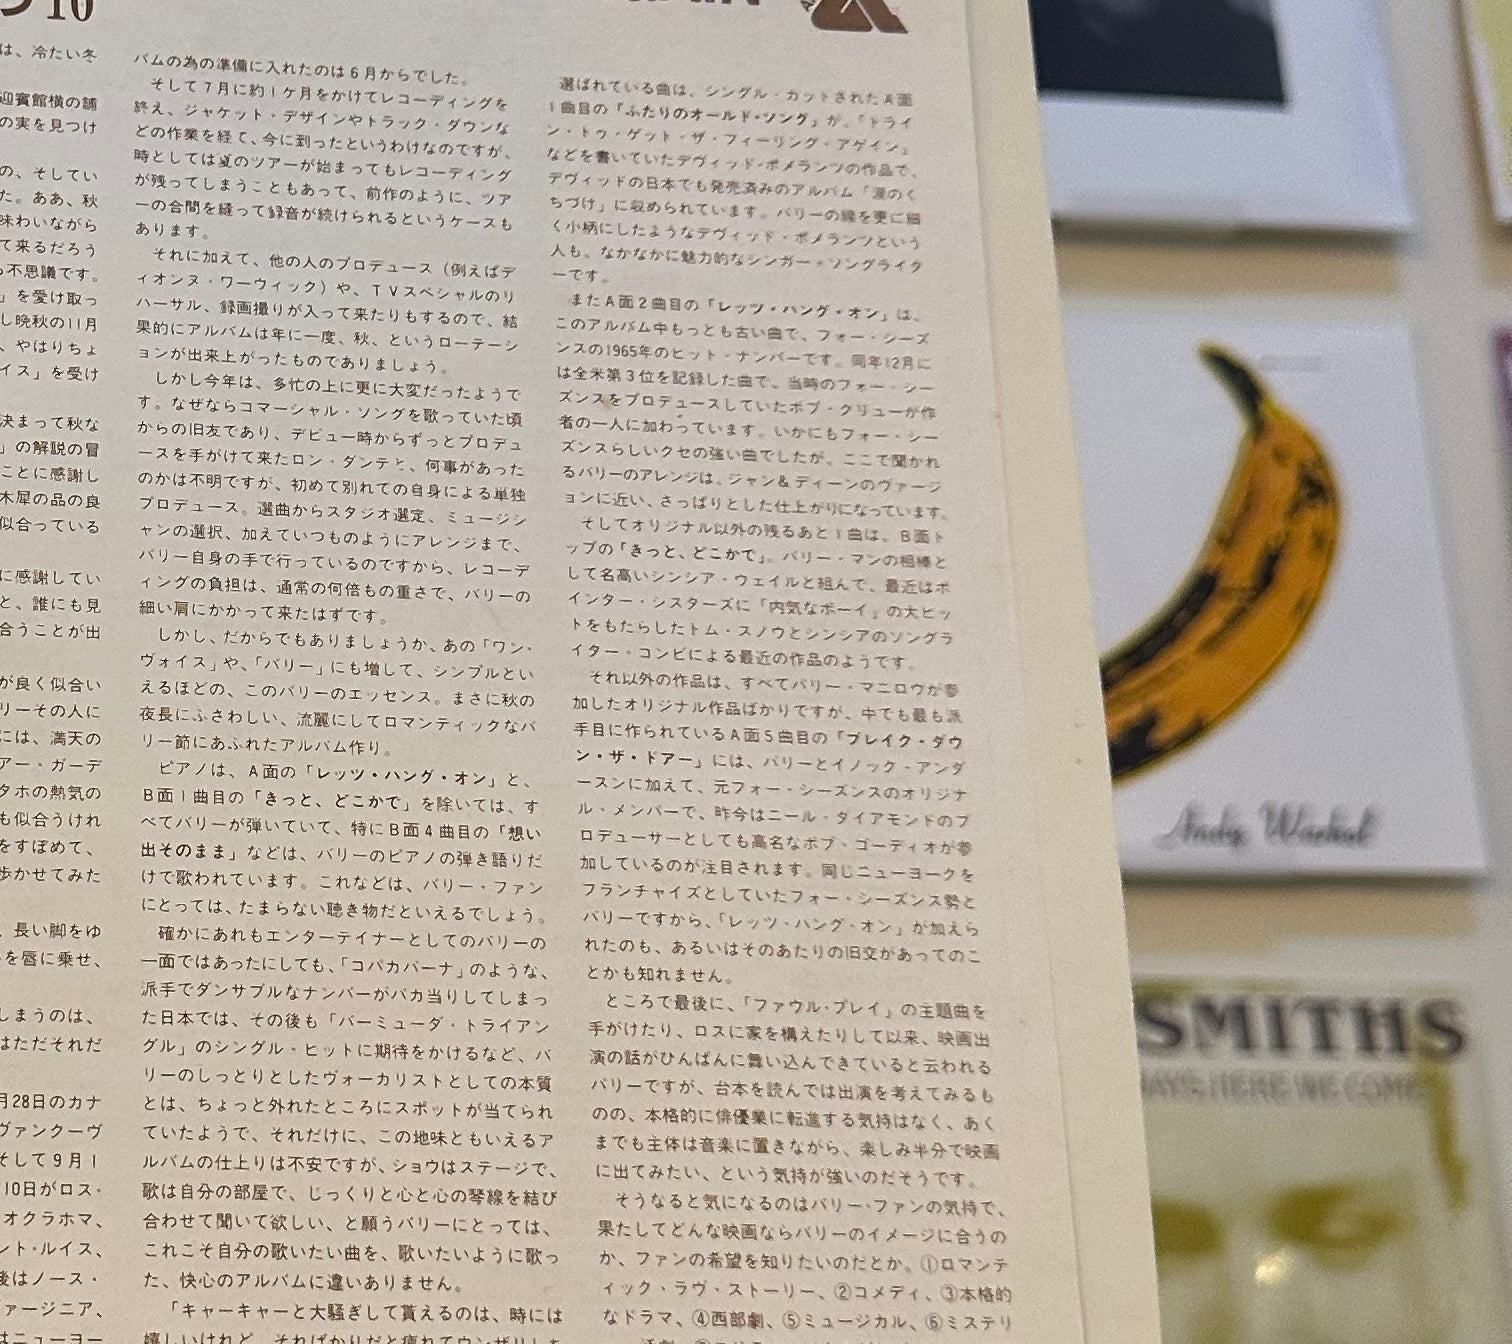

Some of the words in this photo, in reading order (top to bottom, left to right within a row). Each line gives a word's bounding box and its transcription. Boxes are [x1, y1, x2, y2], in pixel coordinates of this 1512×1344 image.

[135, 221, 209, 243] あります。
[587, 965, 723, 984] とかも知れません。
[1133, 993, 1467, 1059] SMITHS
